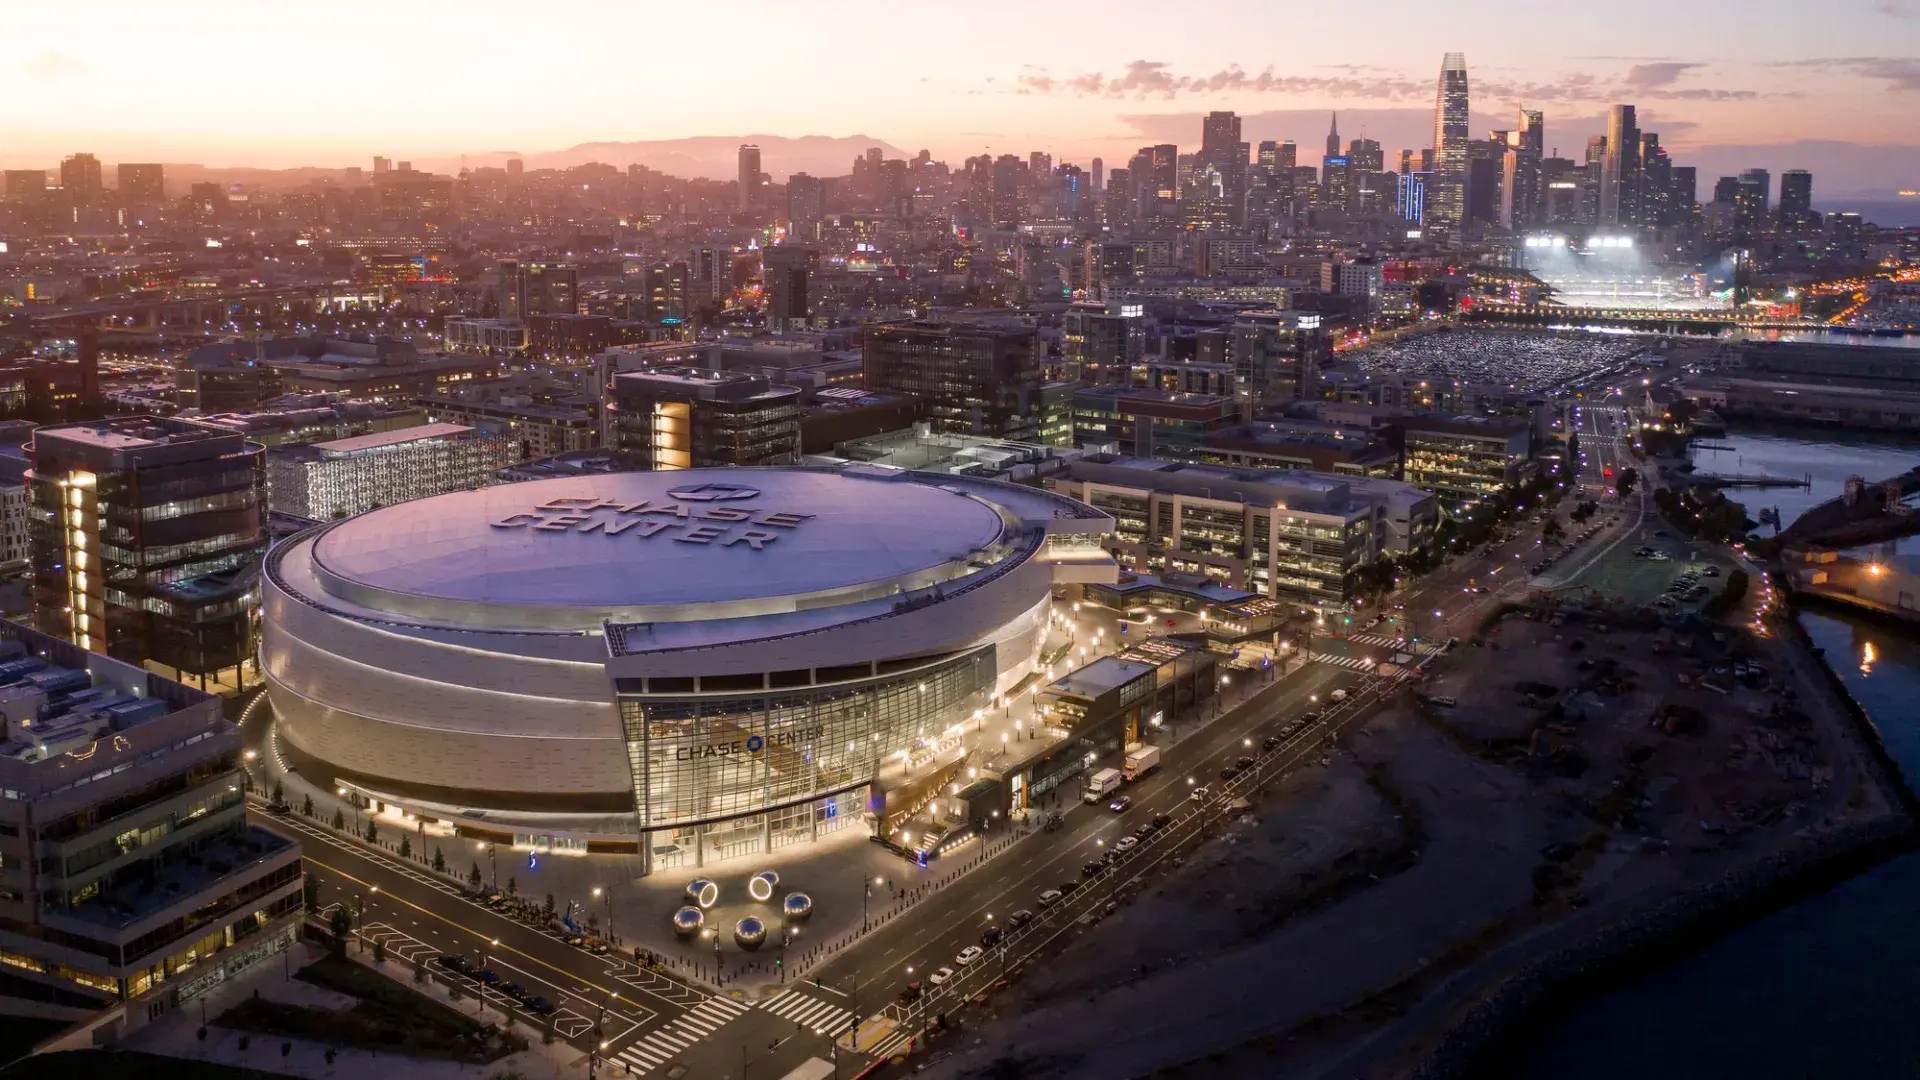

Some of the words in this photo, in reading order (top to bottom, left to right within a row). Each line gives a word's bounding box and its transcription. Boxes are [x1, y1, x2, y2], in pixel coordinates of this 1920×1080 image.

[534, 498, 817, 529] CHASE
[490, 514, 778, 551] CENTER
[676, 740, 742, 761] CHASE
[766, 725, 825, 747] CENTER
